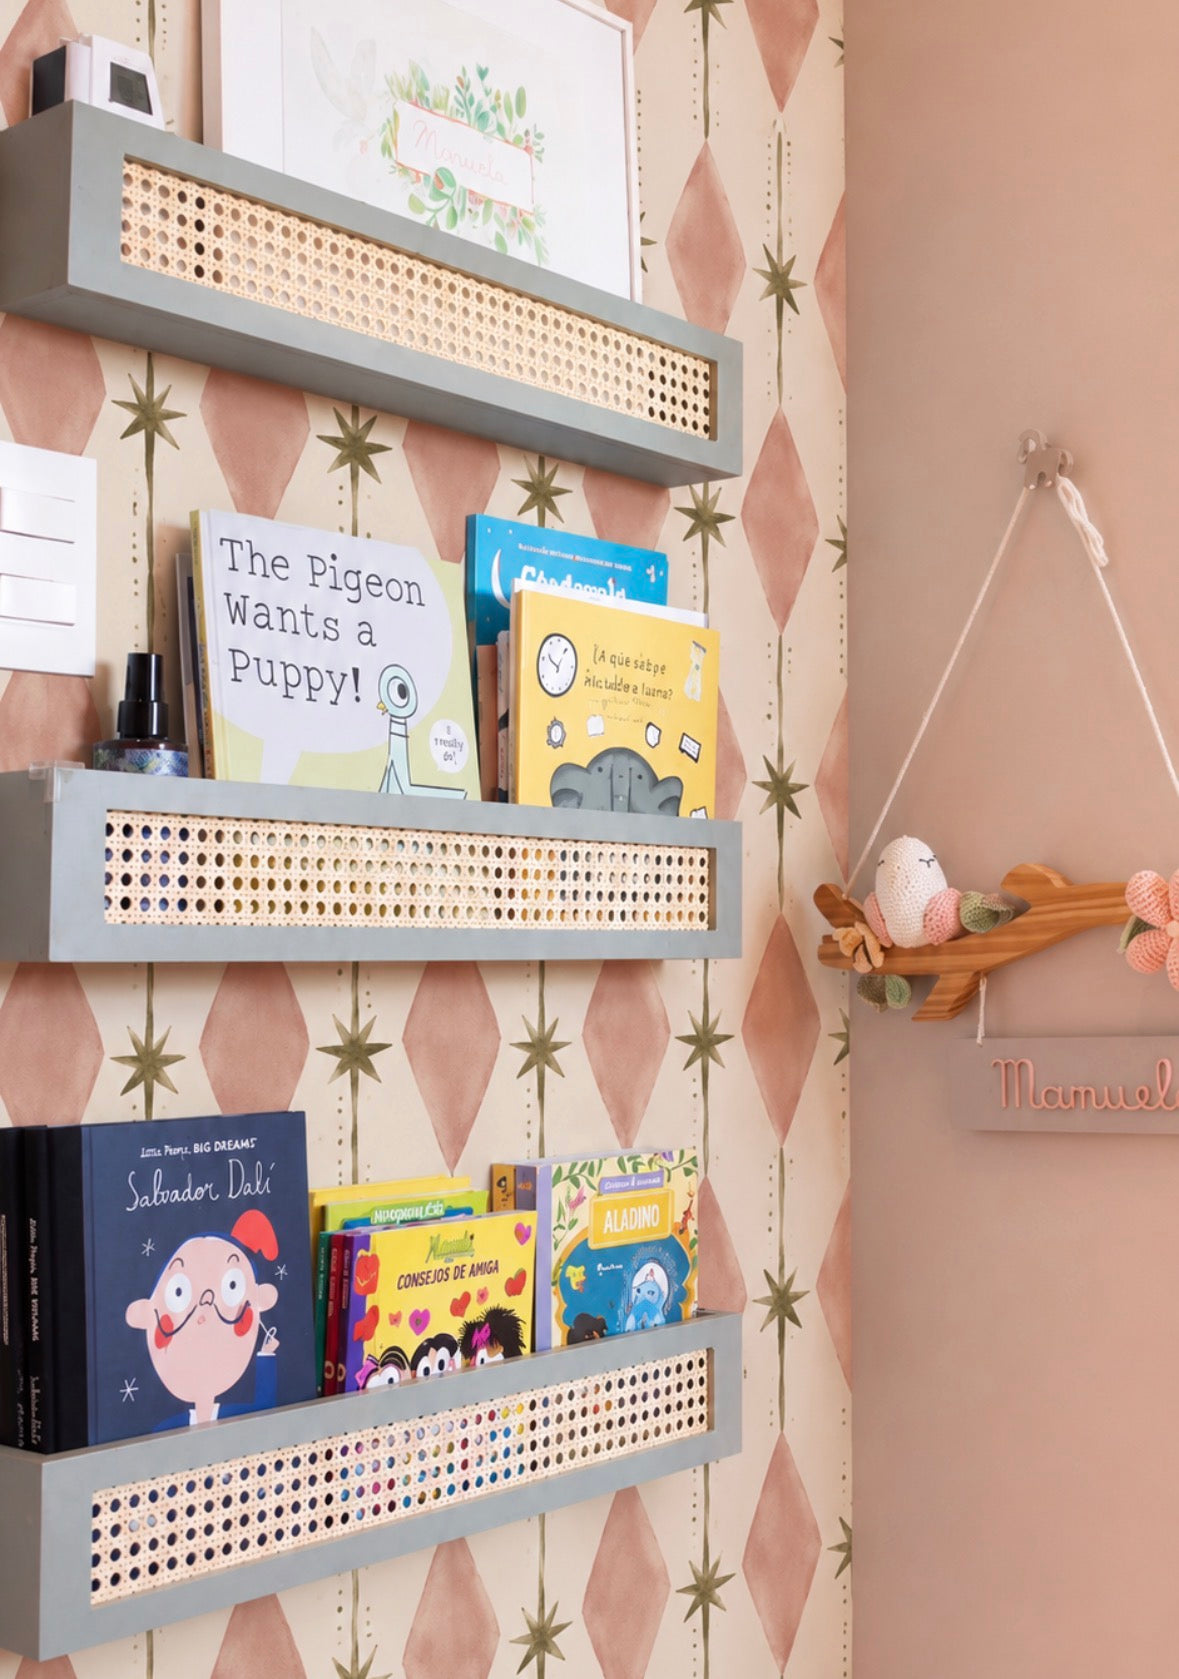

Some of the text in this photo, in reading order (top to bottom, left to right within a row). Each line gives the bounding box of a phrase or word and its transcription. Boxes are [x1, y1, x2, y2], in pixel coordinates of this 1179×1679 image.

[219, 537, 290, 581] The
[306, 552, 426, 607] Pigeon
[223, 592, 377, 647] Wants a
[228, 648, 361, 706] Puppy!
[991, 1058, 1179, 1111] Manuel
[193, 1142, 212, 1154] BIG
[214, 1137, 258, 1152] DREAMS
[126, 1158, 276, 1211] Salvador Dalí
[603, 1204, 660, 1234] ALADINO
[397, 1259, 499, 1290] CONSEJOS DE AMIGA
